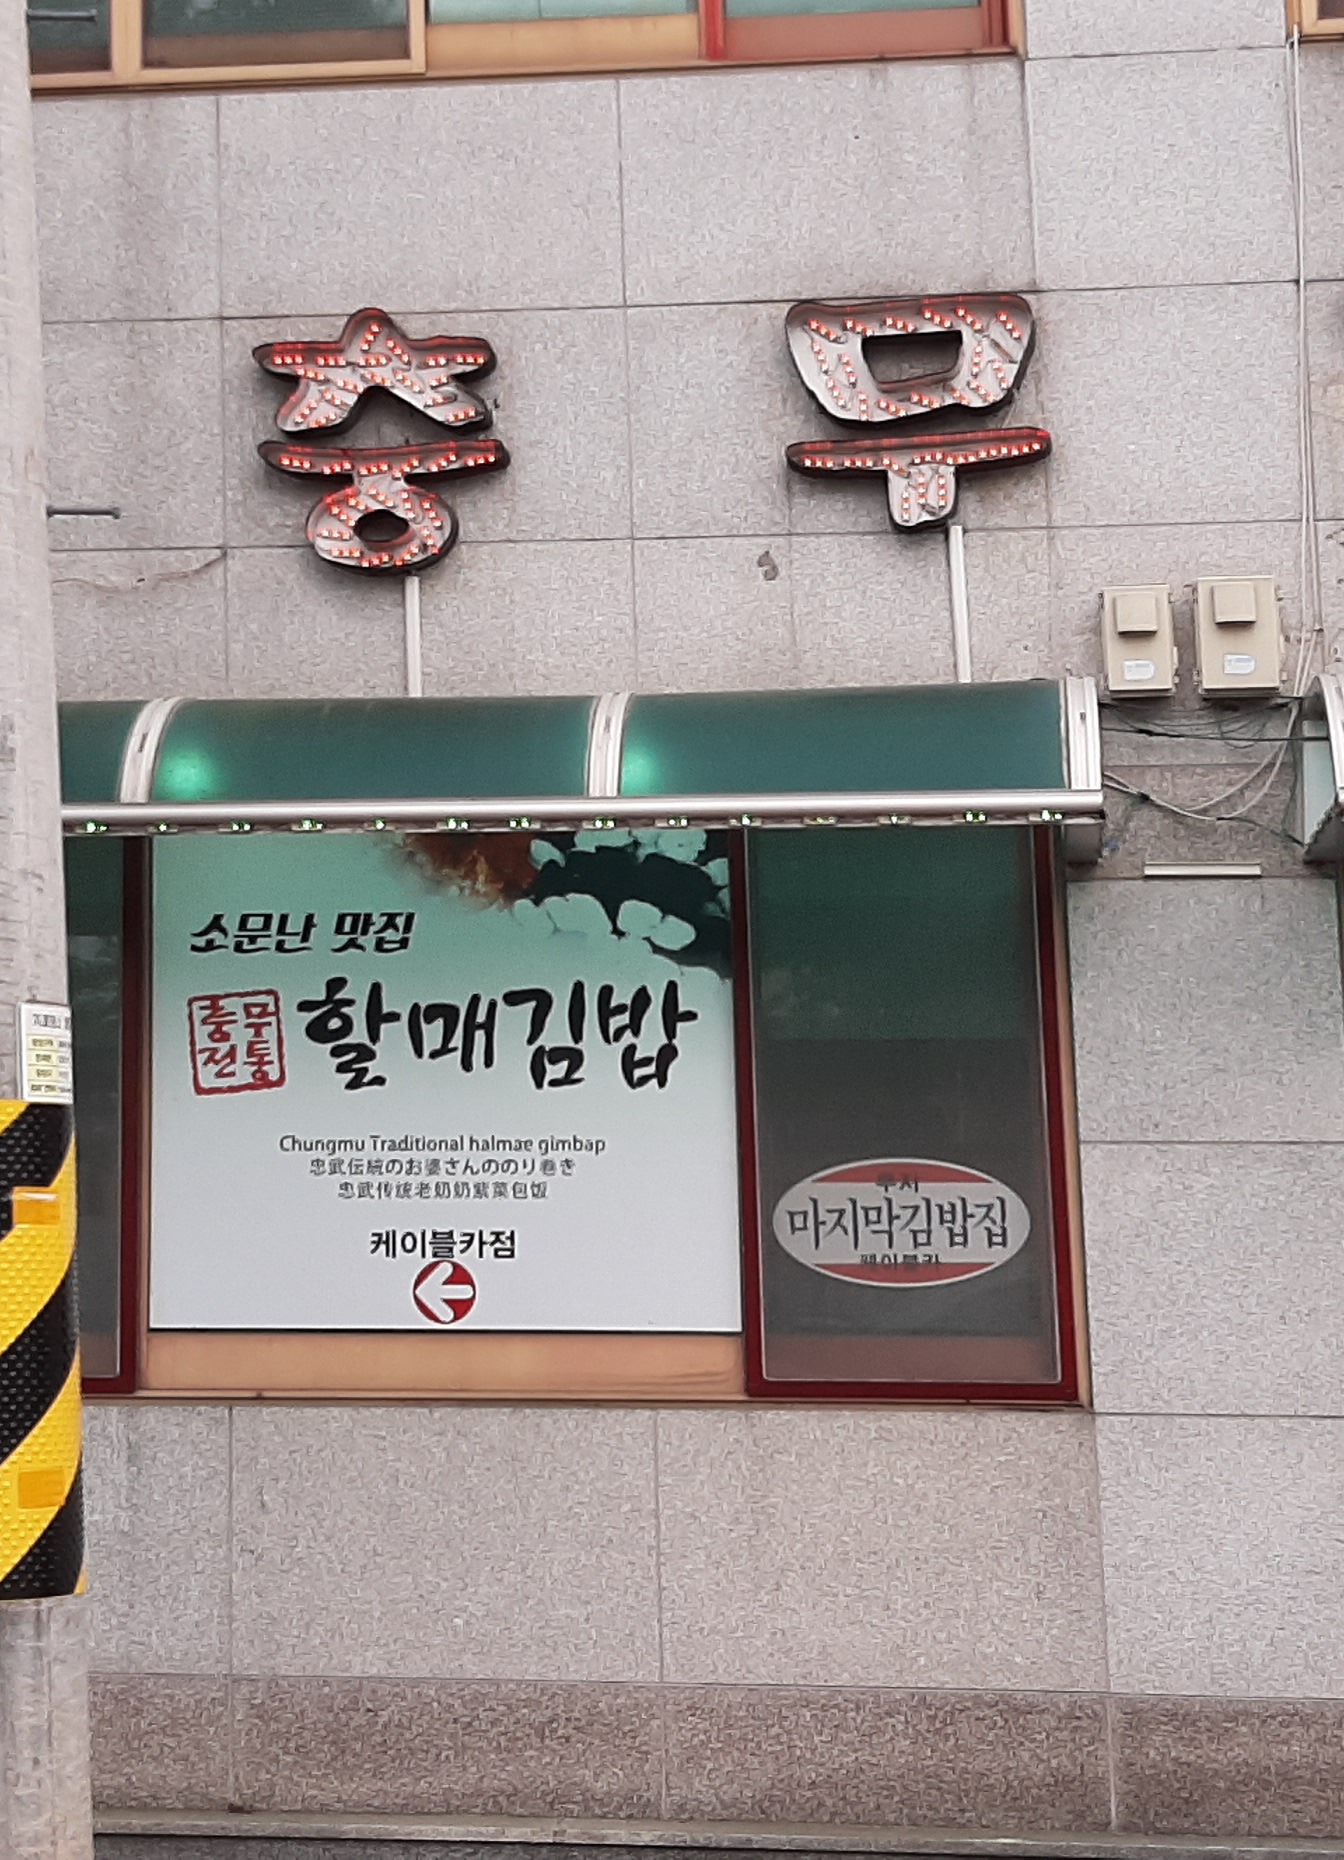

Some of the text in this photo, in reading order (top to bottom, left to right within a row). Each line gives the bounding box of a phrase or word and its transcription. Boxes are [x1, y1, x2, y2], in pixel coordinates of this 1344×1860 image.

[190, 911, 416, 954] 소문난 맛집
[199, 998, 278, 1042] 충무
[297, 976, 699, 1090] 할매김밥
[198, 1041, 274, 1084] 전통
[279, 1134, 606, 1156] Chungmu Traditional halmae gimbap
[369, 1229, 516, 1259] 케이블카점
[786, 1195, 1008, 1251] 마지막김밥집
